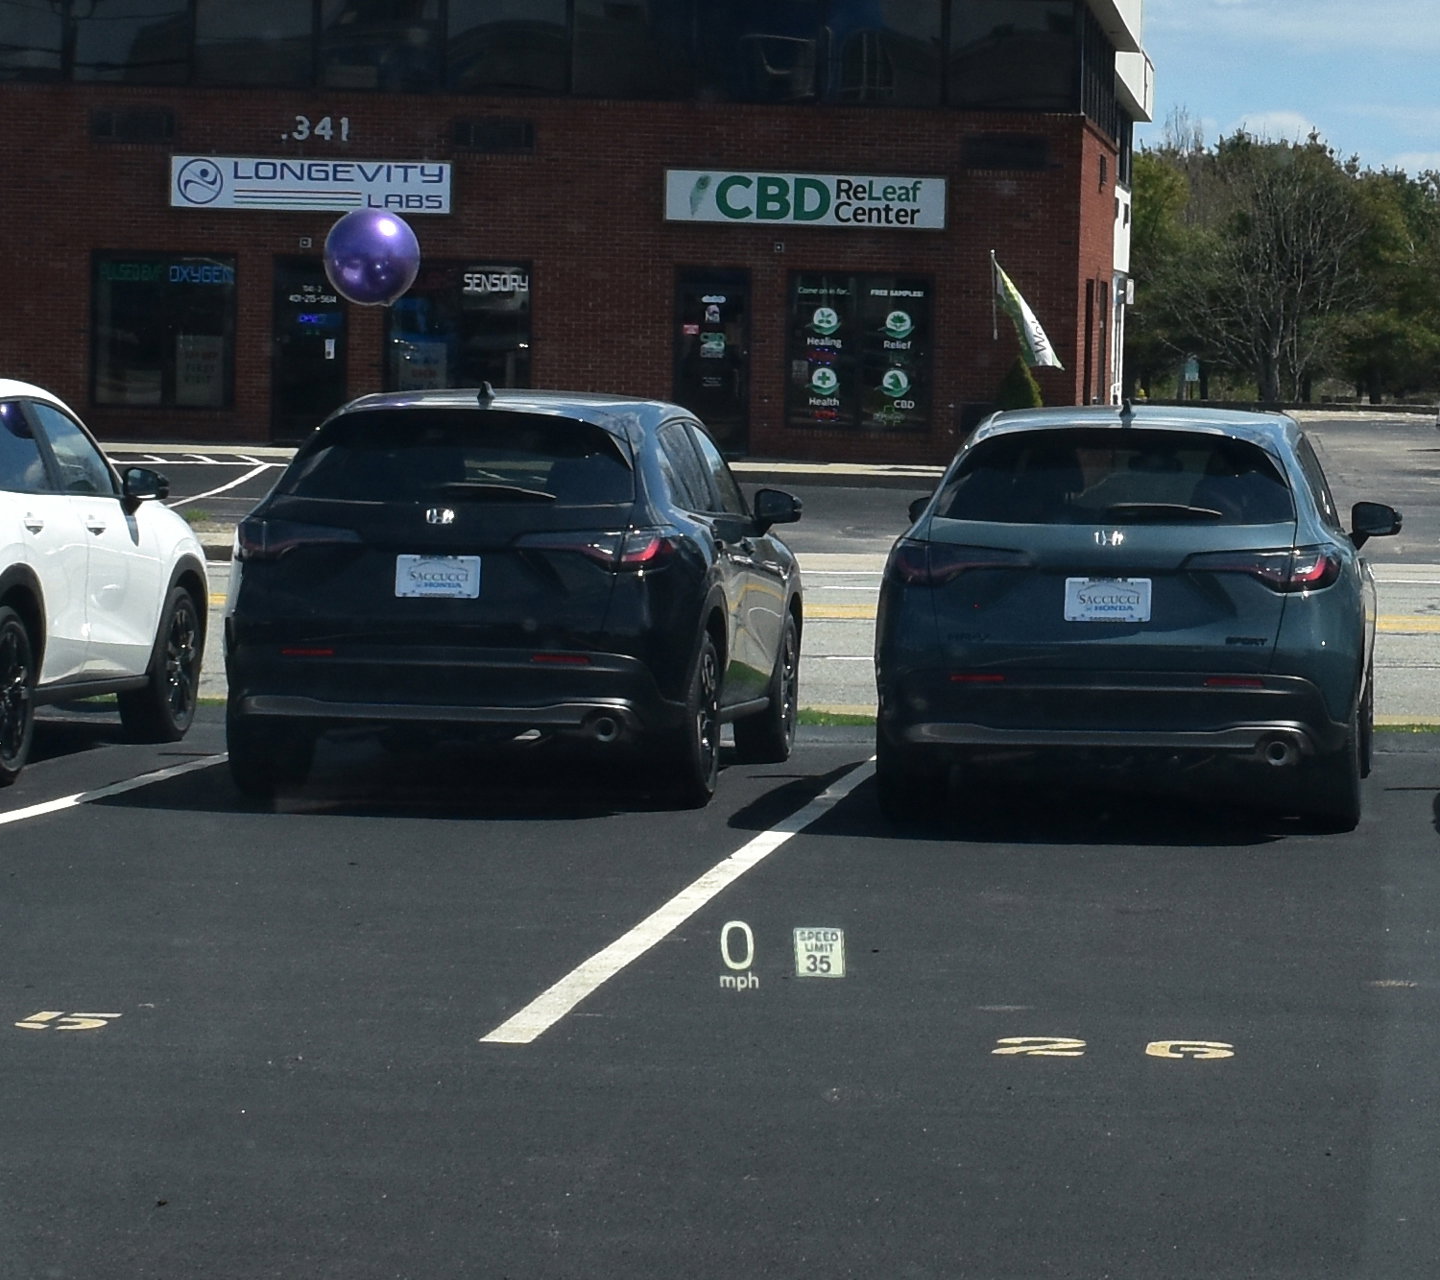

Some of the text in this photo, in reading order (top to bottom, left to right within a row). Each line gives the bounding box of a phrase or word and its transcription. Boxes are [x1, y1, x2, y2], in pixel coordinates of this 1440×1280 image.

[233, 161, 444, 184] LONGEVITY
[715, 175, 831, 220] CBD
[834, 178, 922, 203] ReLeaf
[367, 193, 443, 209] LABS
[833, 201, 921, 225] Center
[169, 265, 235, 285] OXYGEN
[463, 273, 529, 293] SENSORY
[806, 337, 842, 348] Healing
[883, 340, 912, 350] Relief
[808, 397, 840, 406] Health
[893, 400, 915, 409] CBD
[410, 571, 469, 582] SACCUCCI
[1079, 594, 1140, 605] SACCUCCI
[1094, 604, 1134, 612] HONDA
[799, 931, 839, 942] SPEED
[720, 920, 754, 970] 0
[805, 943, 835, 953] LIMIT
[806, 954, 831, 973] 35
[719, 971, 759, 992] mph
